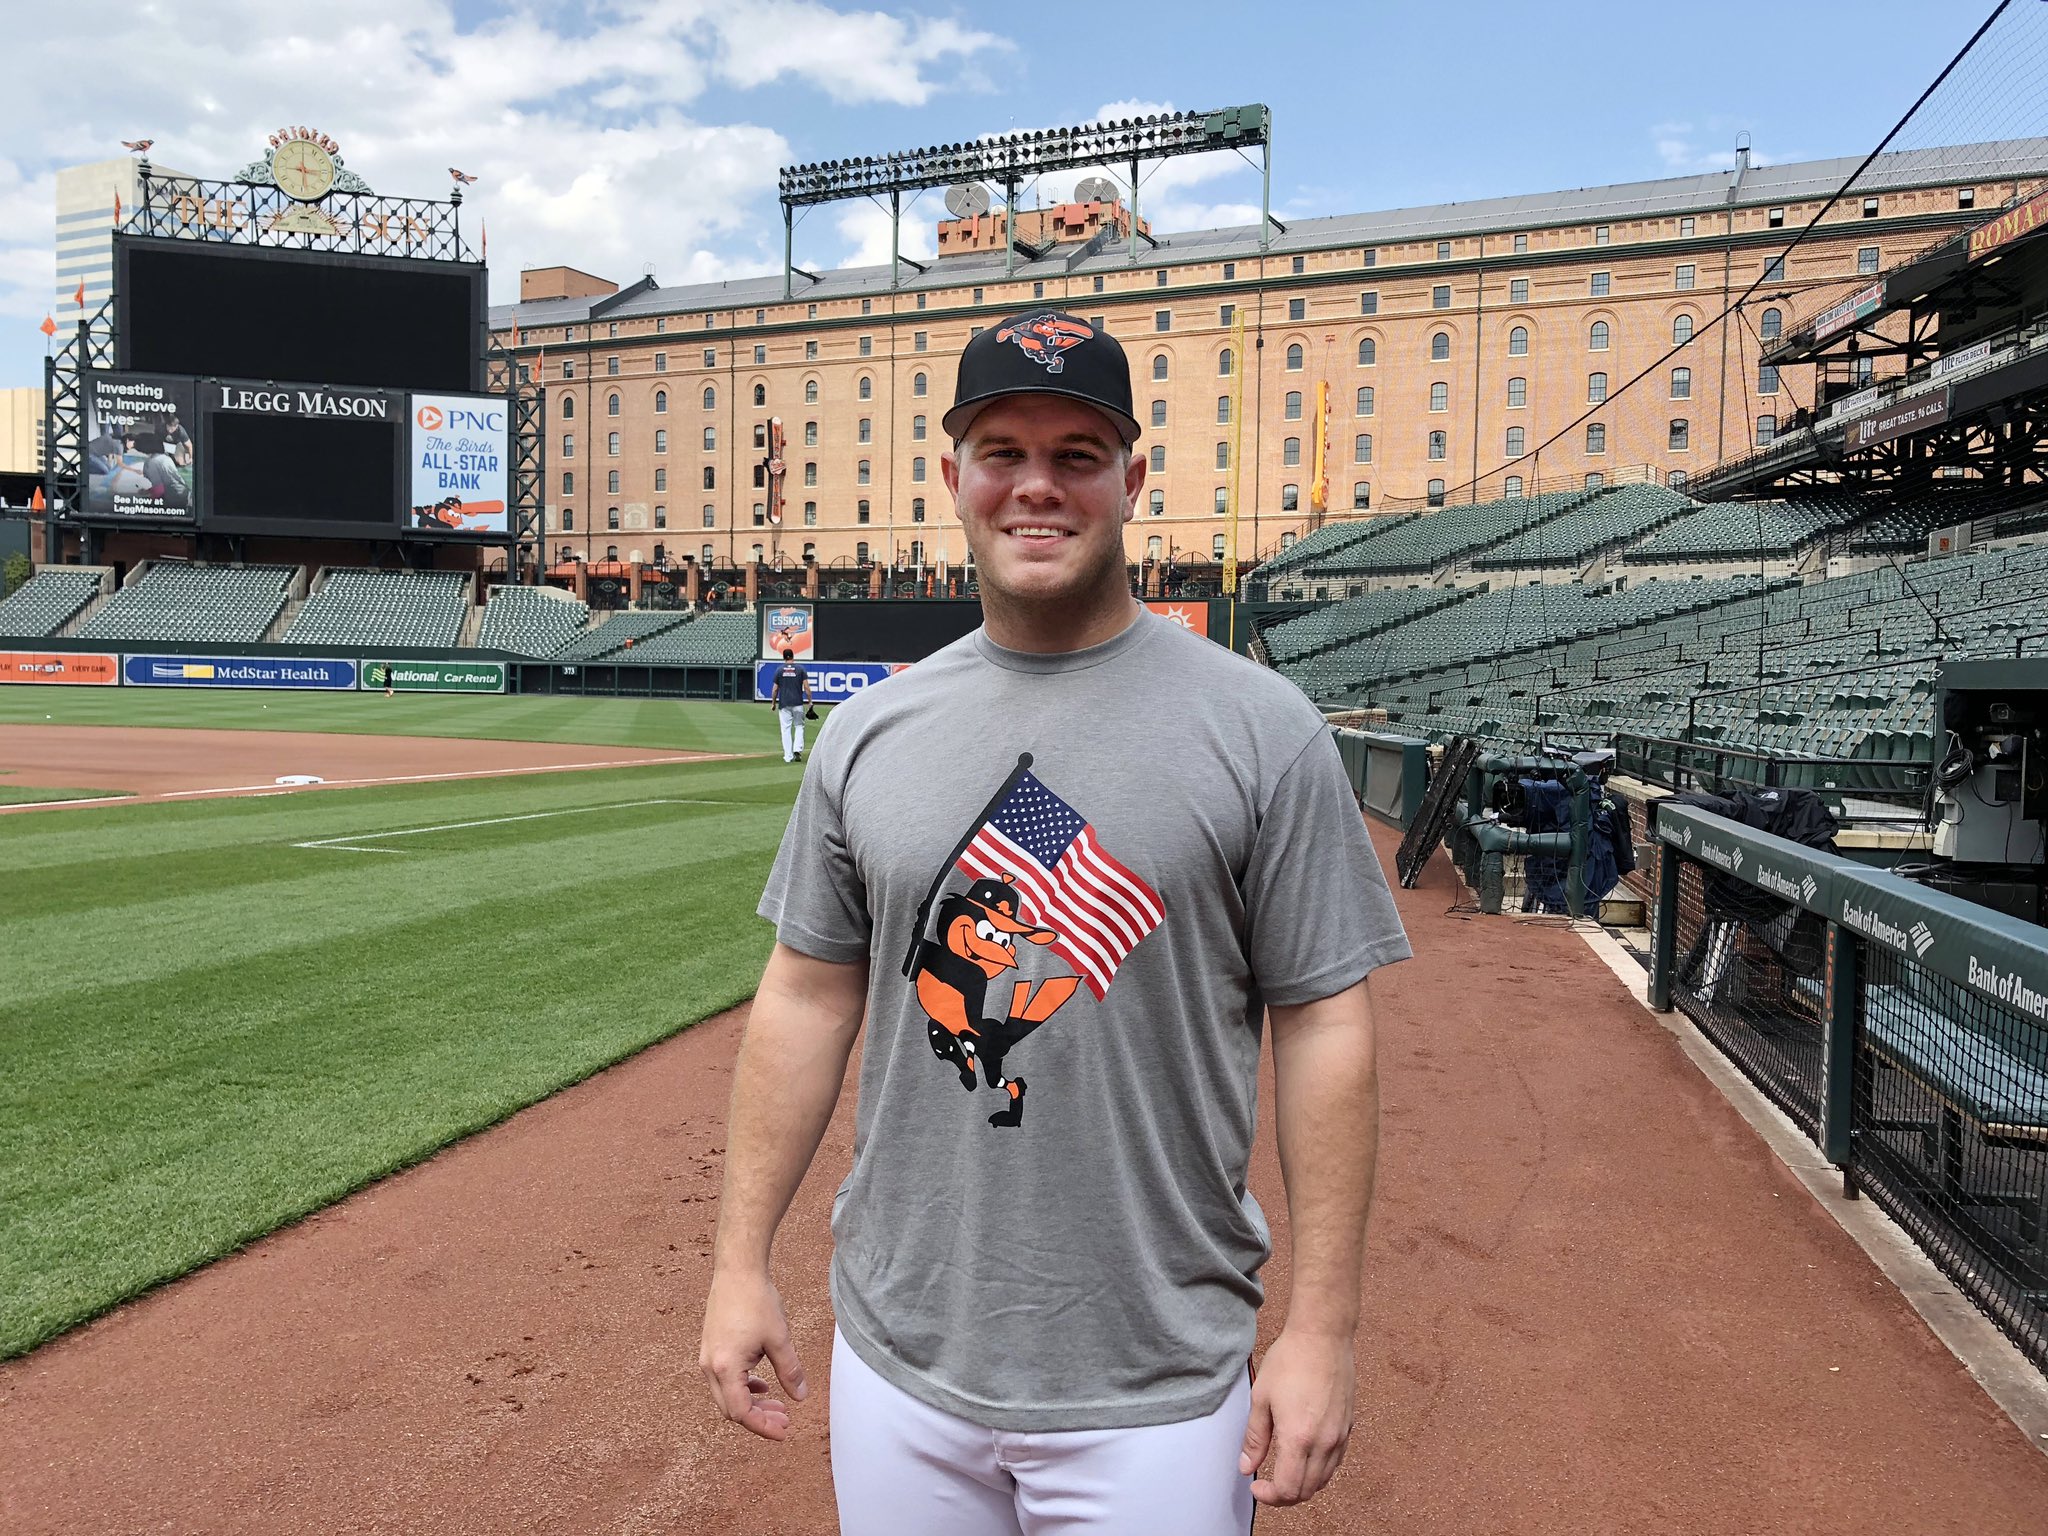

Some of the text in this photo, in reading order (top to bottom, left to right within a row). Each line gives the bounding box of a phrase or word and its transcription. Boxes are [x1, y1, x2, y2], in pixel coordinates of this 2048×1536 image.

[173, 195, 431, 244] THE SUN
[1969, 203, 2037, 259] ROMA
[96, 380, 163, 400] Investing
[96, 397, 176, 413] to Improve
[221, 386, 387, 418] LEGG MASON
[447, 410, 503, 432] PNC
[1859, 419, 1877, 445] Lite
[1879, 416, 1897, 432] GREAT
[1925, 401, 1944, 416] CALS.
[426, 436, 494, 453] The Birds
[422, 452, 498, 472] ALL-STAR
[438, 471, 481, 490] BANK
[113, 495, 164, 506] See how at
[113, 504, 185, 516] LeggMason.com
[772, 615, 805, 626] ESSKAY
[217, 667, 329, 681] MedStar Health
[444, 673, 464, 683] Car
[465, 673, 498, 684] Rental
[563, 667, 575, 675] 373
[802, 671, 869, 693] EICO
[1701, 840, 1711, 860] Bank
[1716, 846, 1732, 869] America
[1757, 864, 1800, 901] Bank of America
[1843, 899, 1907, 952] Bank of America
[1968, 955, 1999, 996] Bank
[1999, 972, 2014, 1002] of
